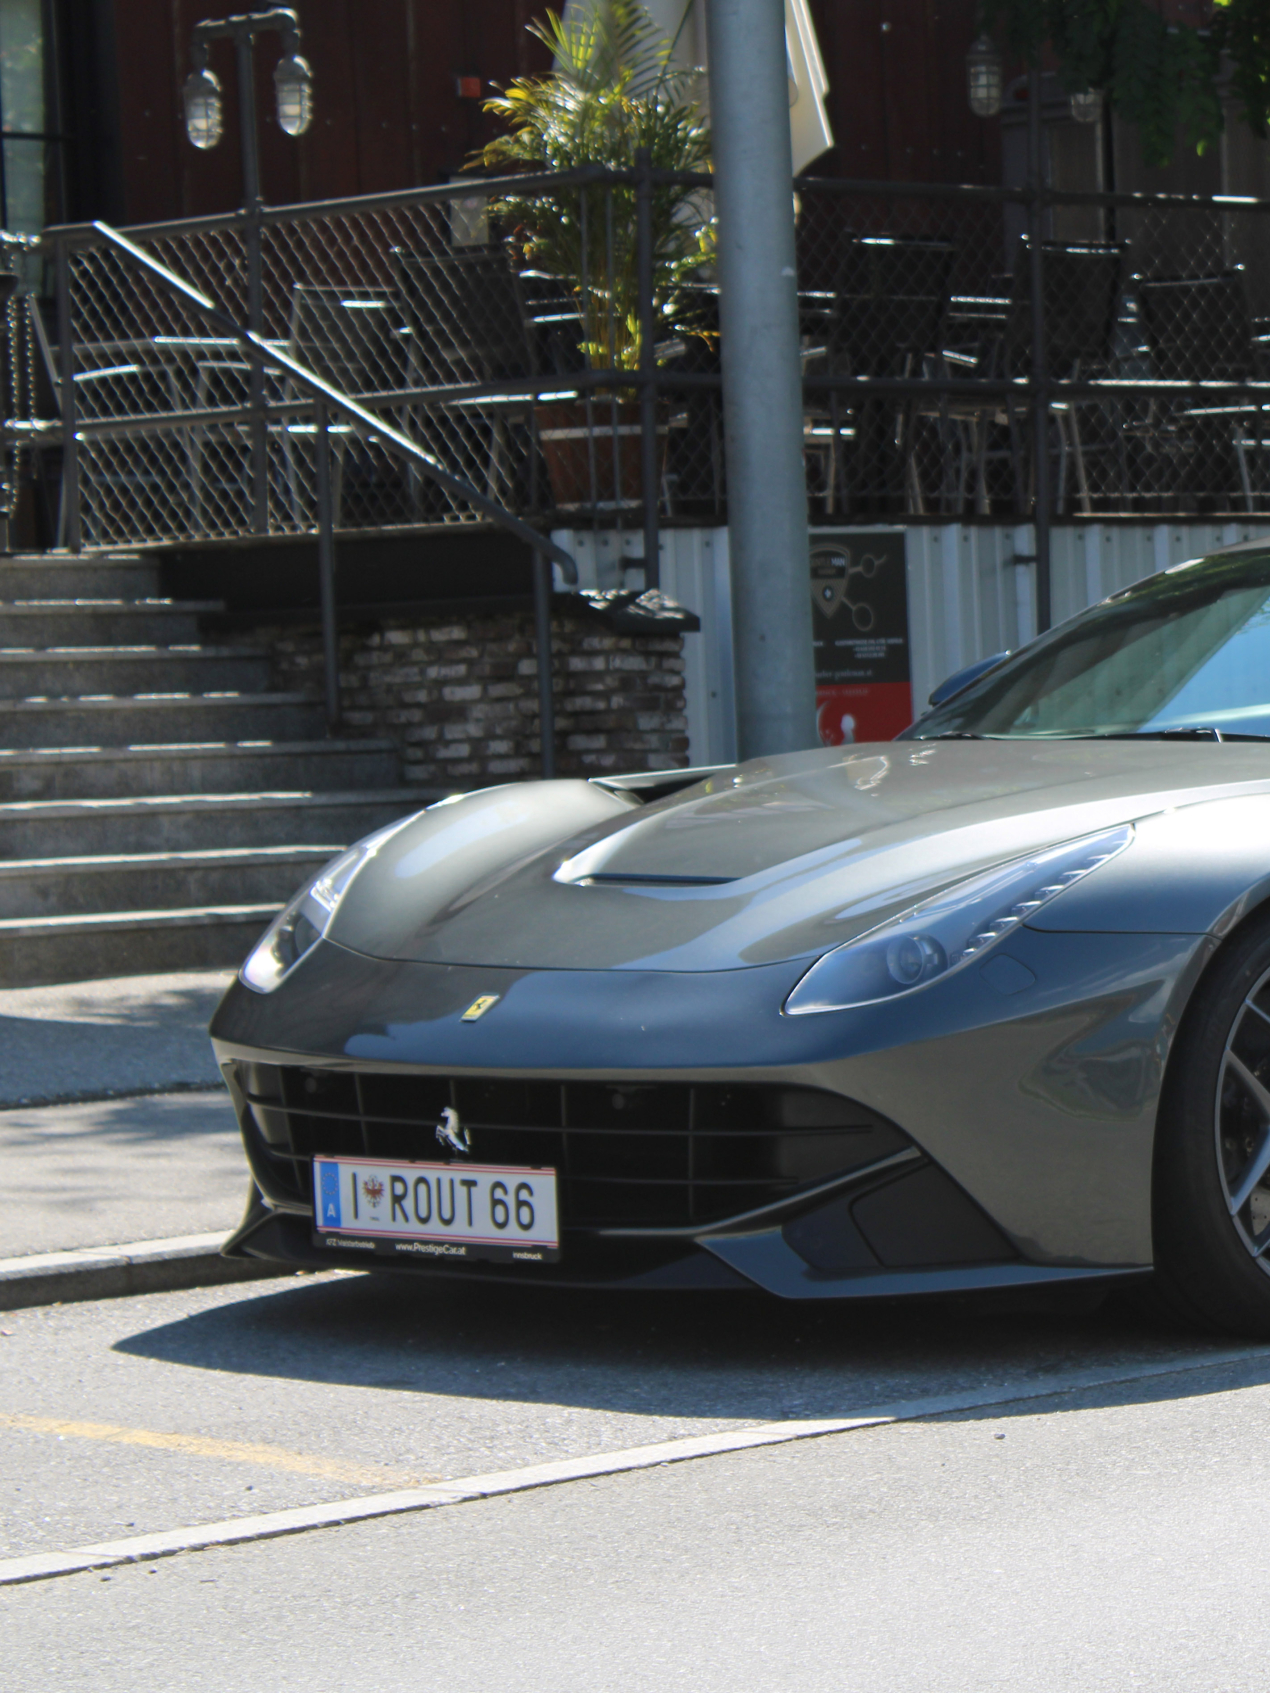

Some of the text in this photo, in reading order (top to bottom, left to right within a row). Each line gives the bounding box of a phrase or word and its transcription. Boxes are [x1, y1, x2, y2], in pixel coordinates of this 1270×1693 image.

[389, 1174, 478, 1228] ROUT
[489, 1180, 536, 1231] 66
[326, 1203, 337, 1218] A
[395, 1242, 466, 1256] www.PrestigeCar.at
